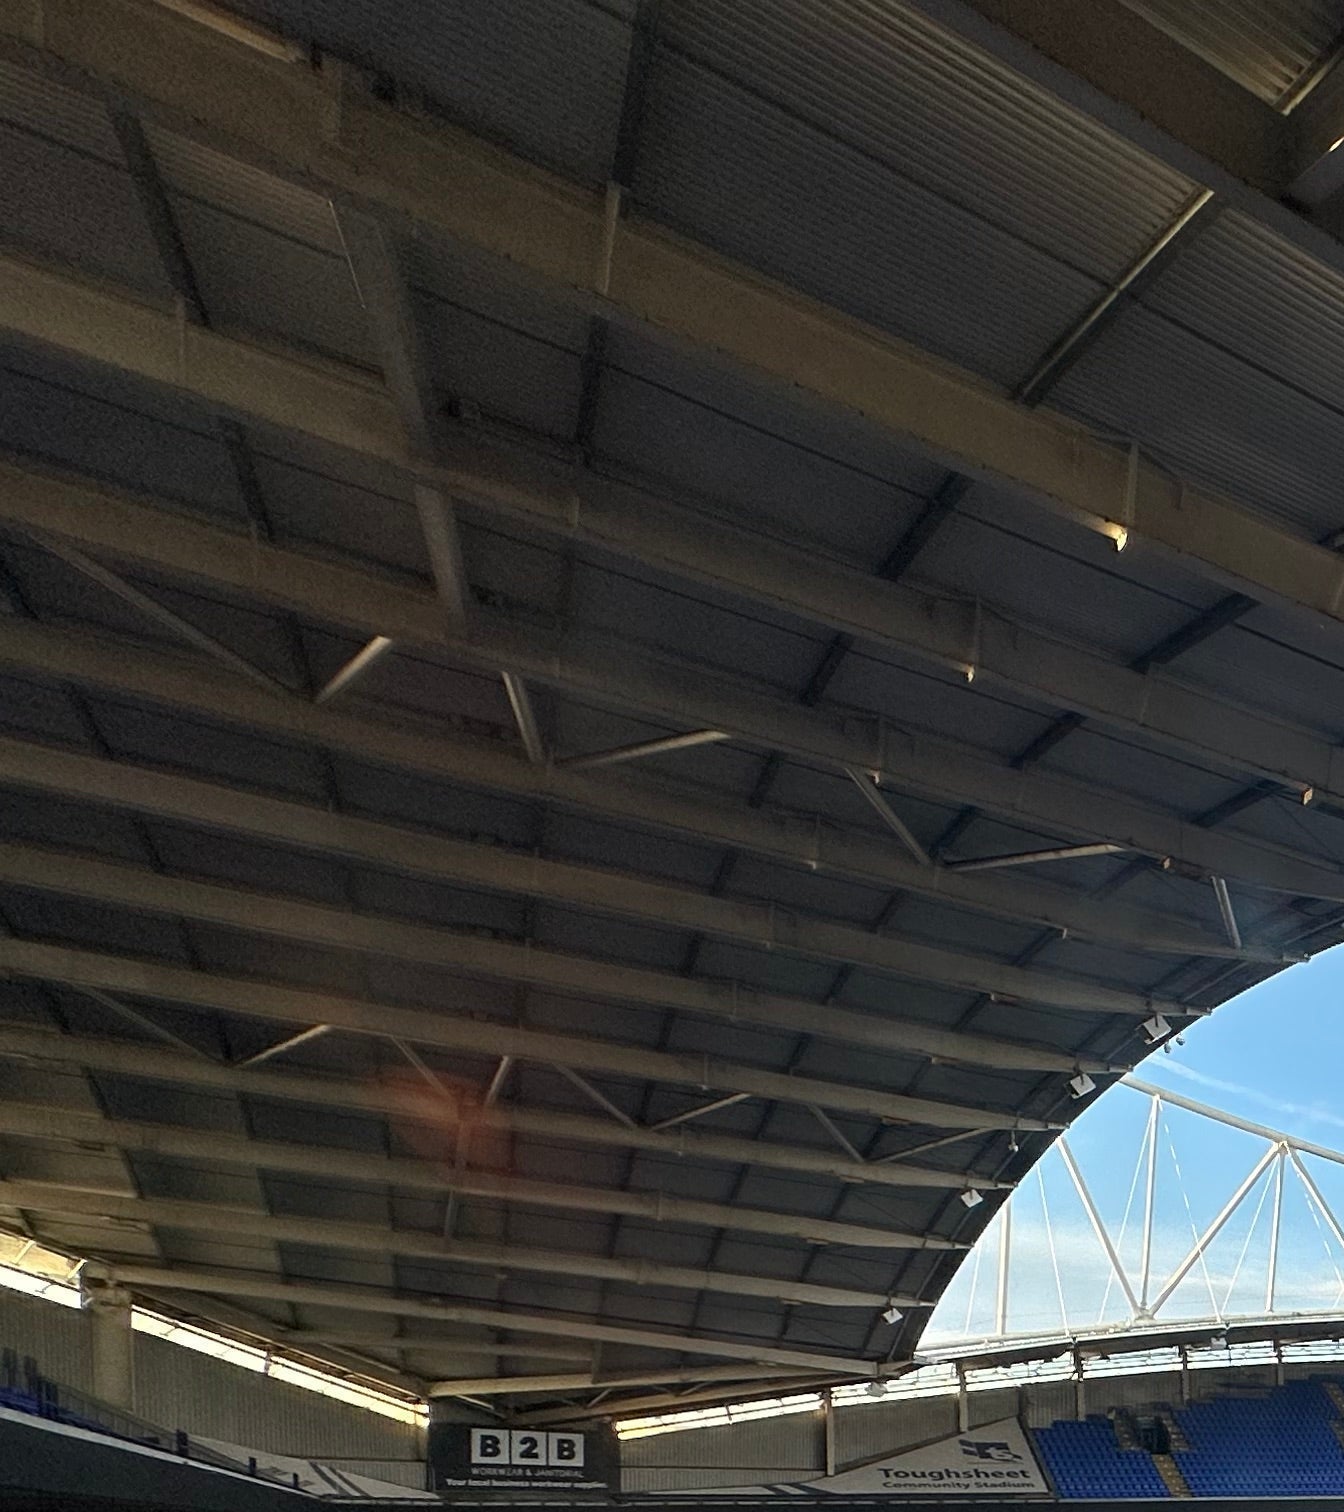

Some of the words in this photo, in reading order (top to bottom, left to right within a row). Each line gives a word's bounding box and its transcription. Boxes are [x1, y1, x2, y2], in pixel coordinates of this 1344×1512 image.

[480, 1435, 576, 1460] B2B
[878, 1468, 1030, 1481] Toughsheet
[883, 1481, 970, 1490] Community
[974, 1481, 1035, 1489] Stadium
